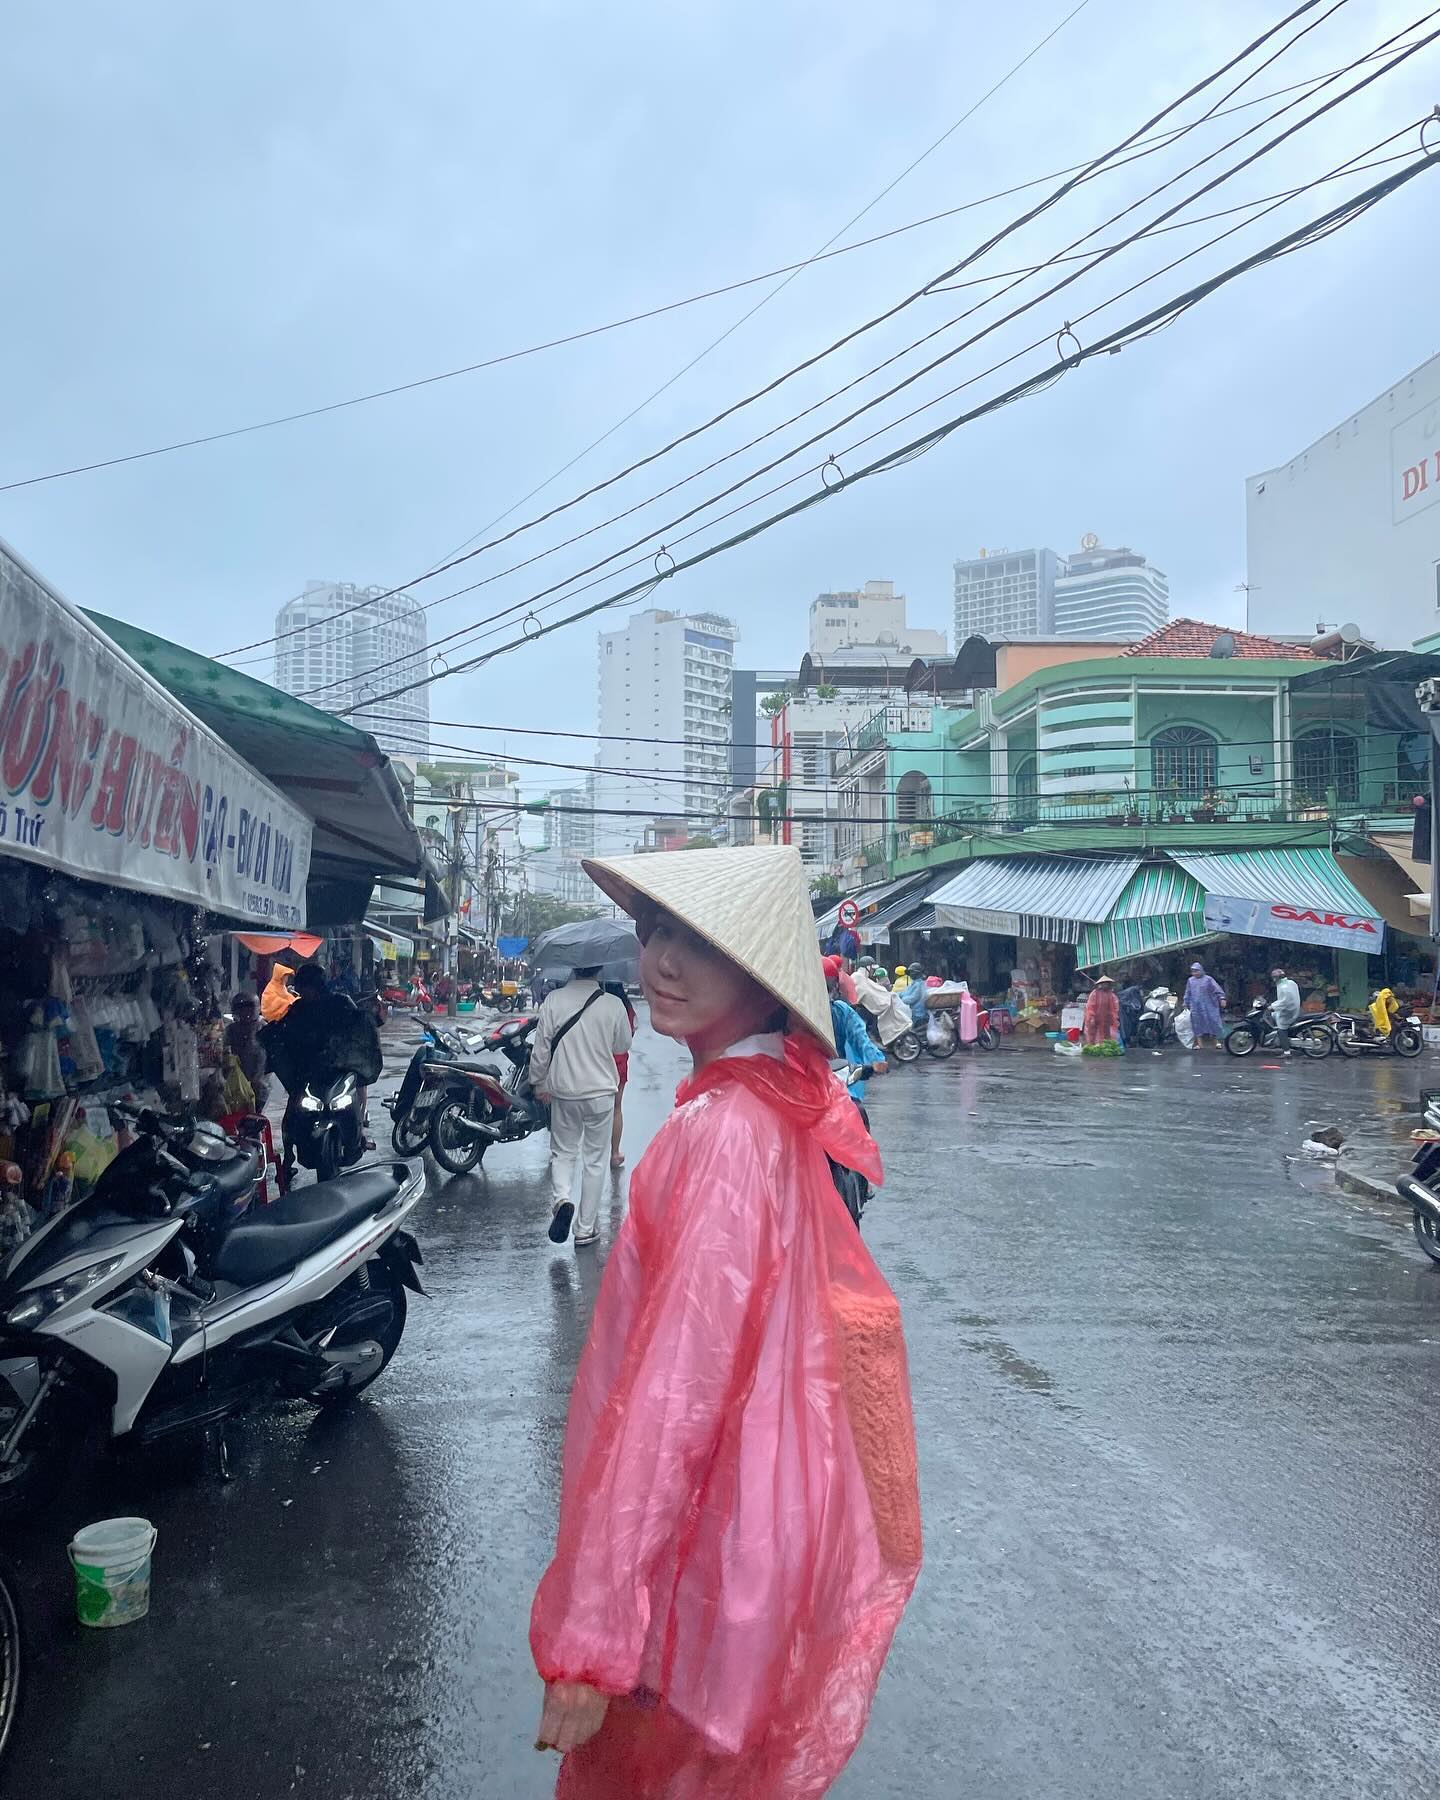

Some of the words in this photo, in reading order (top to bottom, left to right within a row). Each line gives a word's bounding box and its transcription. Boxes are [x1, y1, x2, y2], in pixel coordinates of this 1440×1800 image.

[1402, 458, 1428, 501] DI
[15, 807, 45, 847] Trứ
[1271, 905, 1377, 933] SAKA
